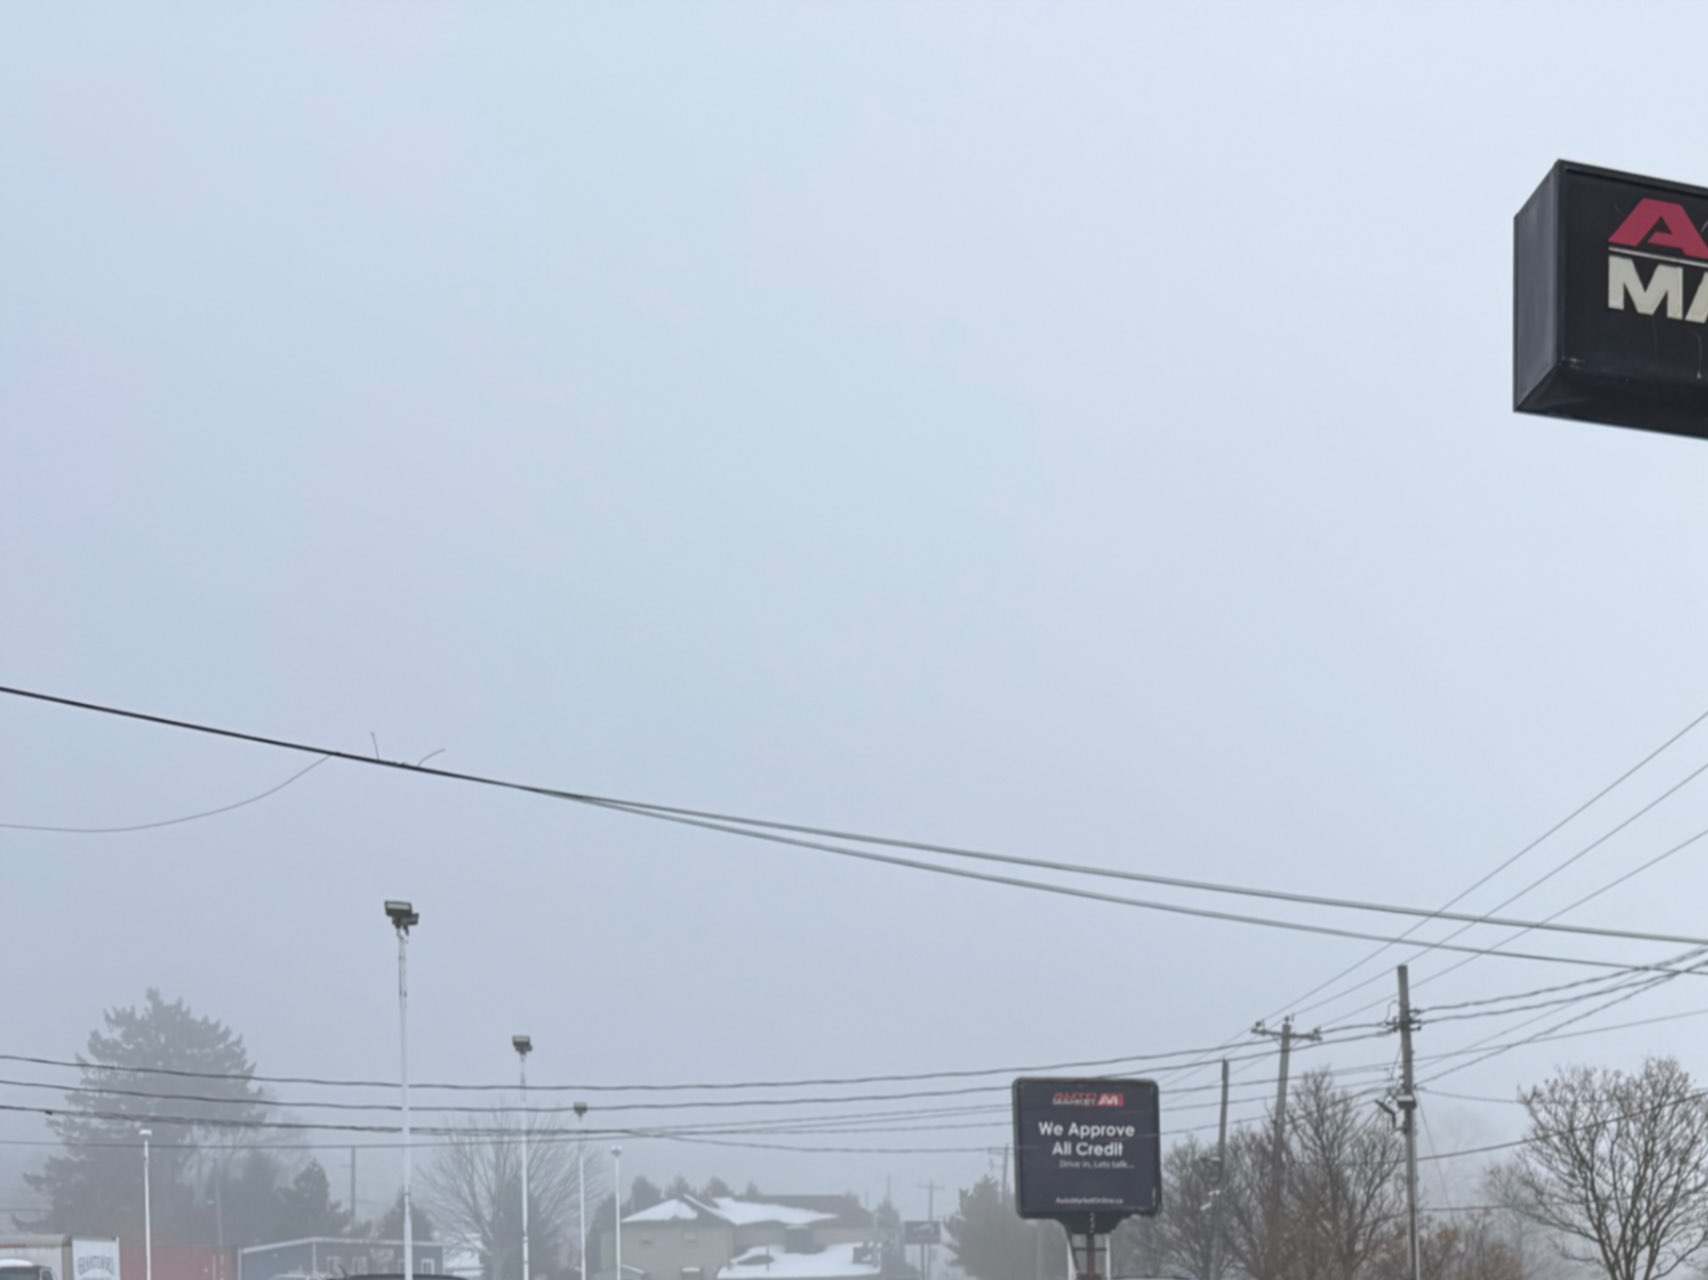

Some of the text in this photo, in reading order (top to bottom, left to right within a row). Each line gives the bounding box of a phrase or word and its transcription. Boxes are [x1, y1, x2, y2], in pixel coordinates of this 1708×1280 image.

[1038, 1121, 1135, 1139] We Approve
[1052, 1142, 1124, 1156] All Credit
